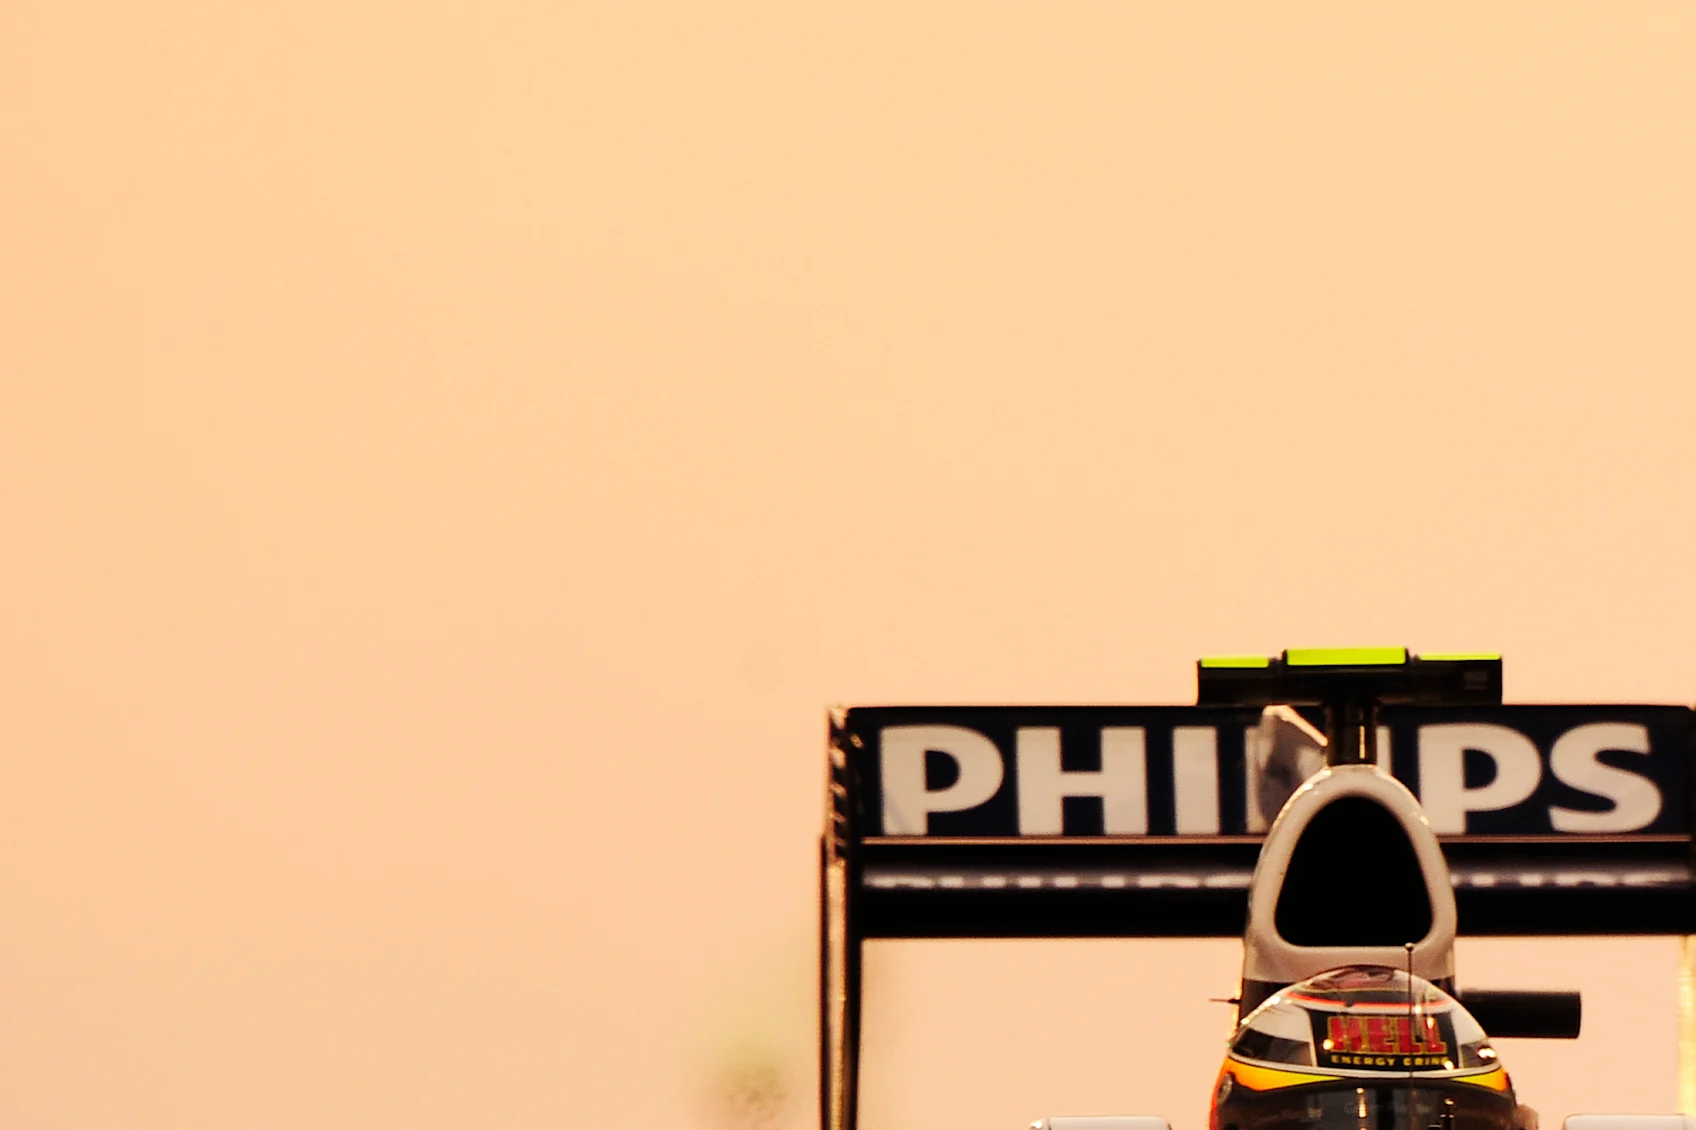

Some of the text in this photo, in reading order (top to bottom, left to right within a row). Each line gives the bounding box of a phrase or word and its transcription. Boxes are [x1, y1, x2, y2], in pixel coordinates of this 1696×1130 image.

[879, 721, 1663, 836] PHIPS
[1328, 1015, 1448, 1054] HELL
[1331, 1055, 1396, 1067] ENERGY
